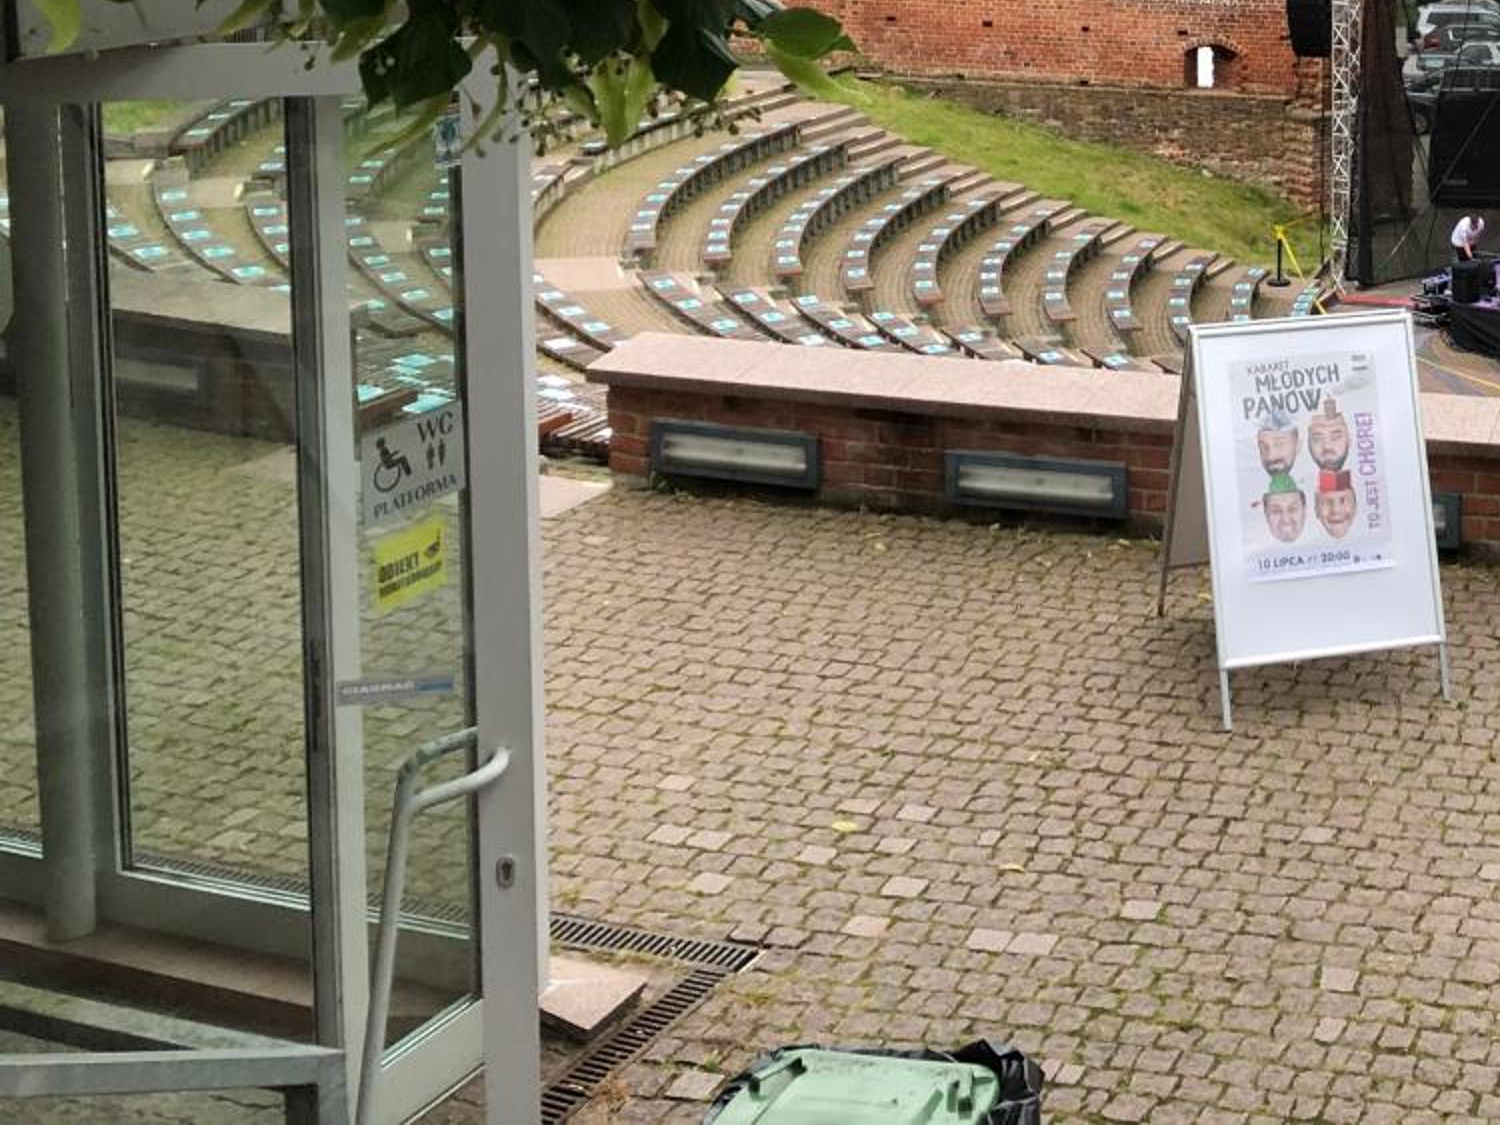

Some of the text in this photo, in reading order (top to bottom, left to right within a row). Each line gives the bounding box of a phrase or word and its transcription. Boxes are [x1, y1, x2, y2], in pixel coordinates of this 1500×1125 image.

[1255, 362, 1341, 393] MŁODYCH
[416, 411, 454, 444] WC
[373, 475, 457, 520] PLATFORMA
[1258, 556, 1270, 569] 10
[1273, 555, 1305, 568] LIPCA
